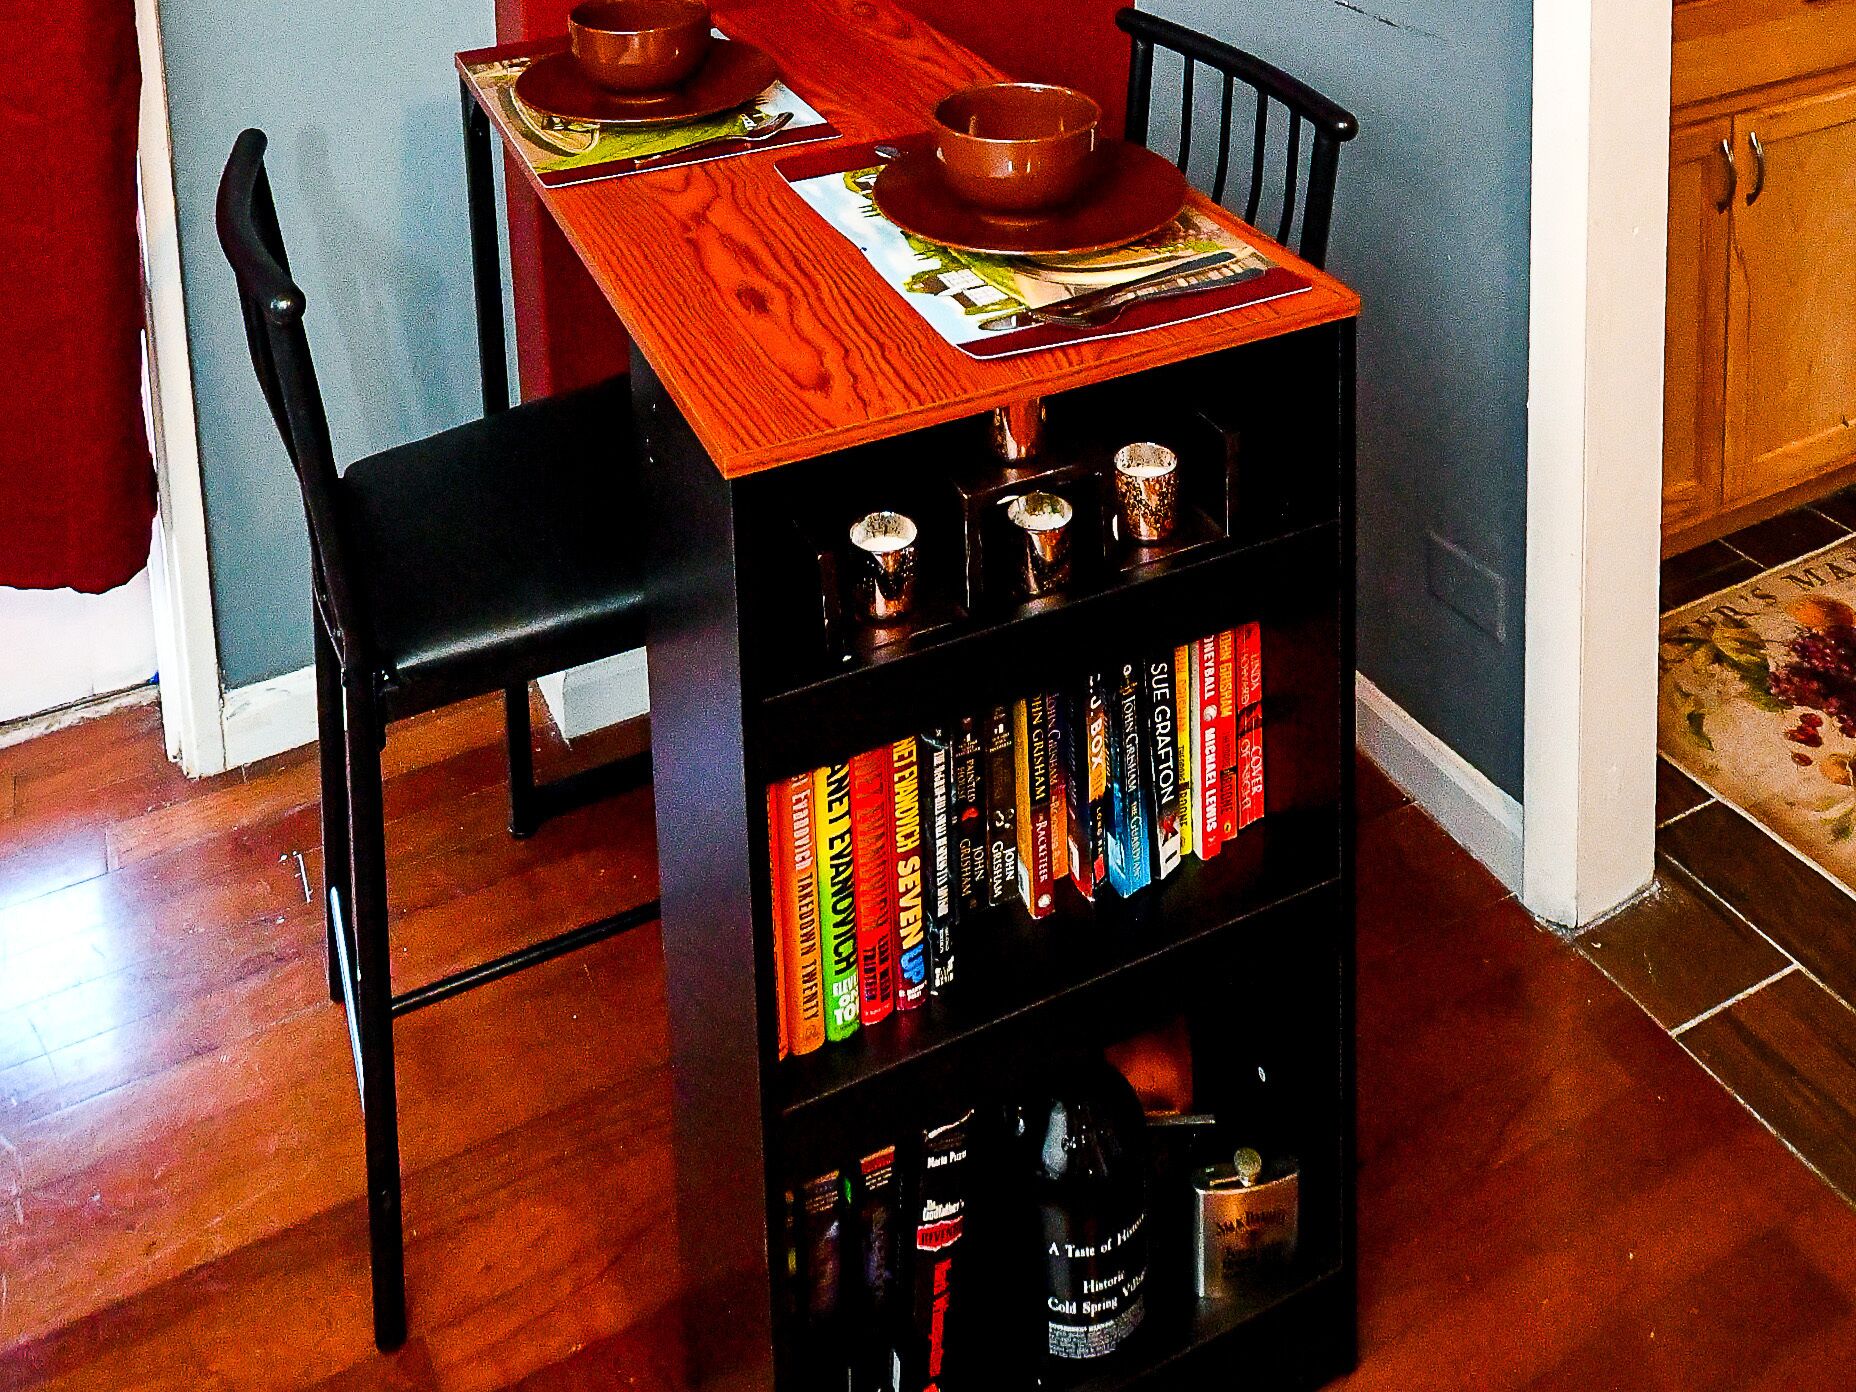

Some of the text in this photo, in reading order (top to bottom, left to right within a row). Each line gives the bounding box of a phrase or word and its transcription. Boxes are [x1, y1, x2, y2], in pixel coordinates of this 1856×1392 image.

[1150, 663, 1169, 703] SUE
[1220, 662, 1232, 717] GRISHAM
[1122, 695, 1136, 733] JOHN
[892, 736, 916, 763] NET
[1032, 729, 1047, 800] GRISHAM
[1090, 720, 1104, 770] BOX
[1123, 733, 1140, 793] GRISHAM
[1153, 705, 1175, 804] GRAFTON
[1204, 727, 1216, 789] MICHAEL
[1241, 739, 1250, 758] OF
[1251, 746, 1262, 795] COVER
[791, 789, 813, 871] Evanovich
[894, 769, 921, 853] EVANOVICH
[1205, 789, 1217, 832] LEWIS
[825, 763, 858, 976] ANET EVANOVICH
[959, 838, 972, 897] GRISHAM
[972, 846, 984, 882] JOHN
[991, 840, 1003, 899] GRISHAM
[1003, 847, 1016, 882] JOHN
[1036, 820, 1048, 883] RACKETEER
[797, 872, 816, 958] TAKEDOWN
[897, 856, 925, 949] SEVEN
[801, 959, 819, 1022] TWENTY
[900, 943, 926, 985] UP
[1048, 1241, 1060, 1256] A
[1065, 1243, 1096, 1258] Taste
[1100, 1238, 1112, 1254] of
[1047, 1295, 1077, 1315] Cold
[1082, 1296, 1118, 1318] Spring
[1082, 1269, 1125, 1294] Historic
